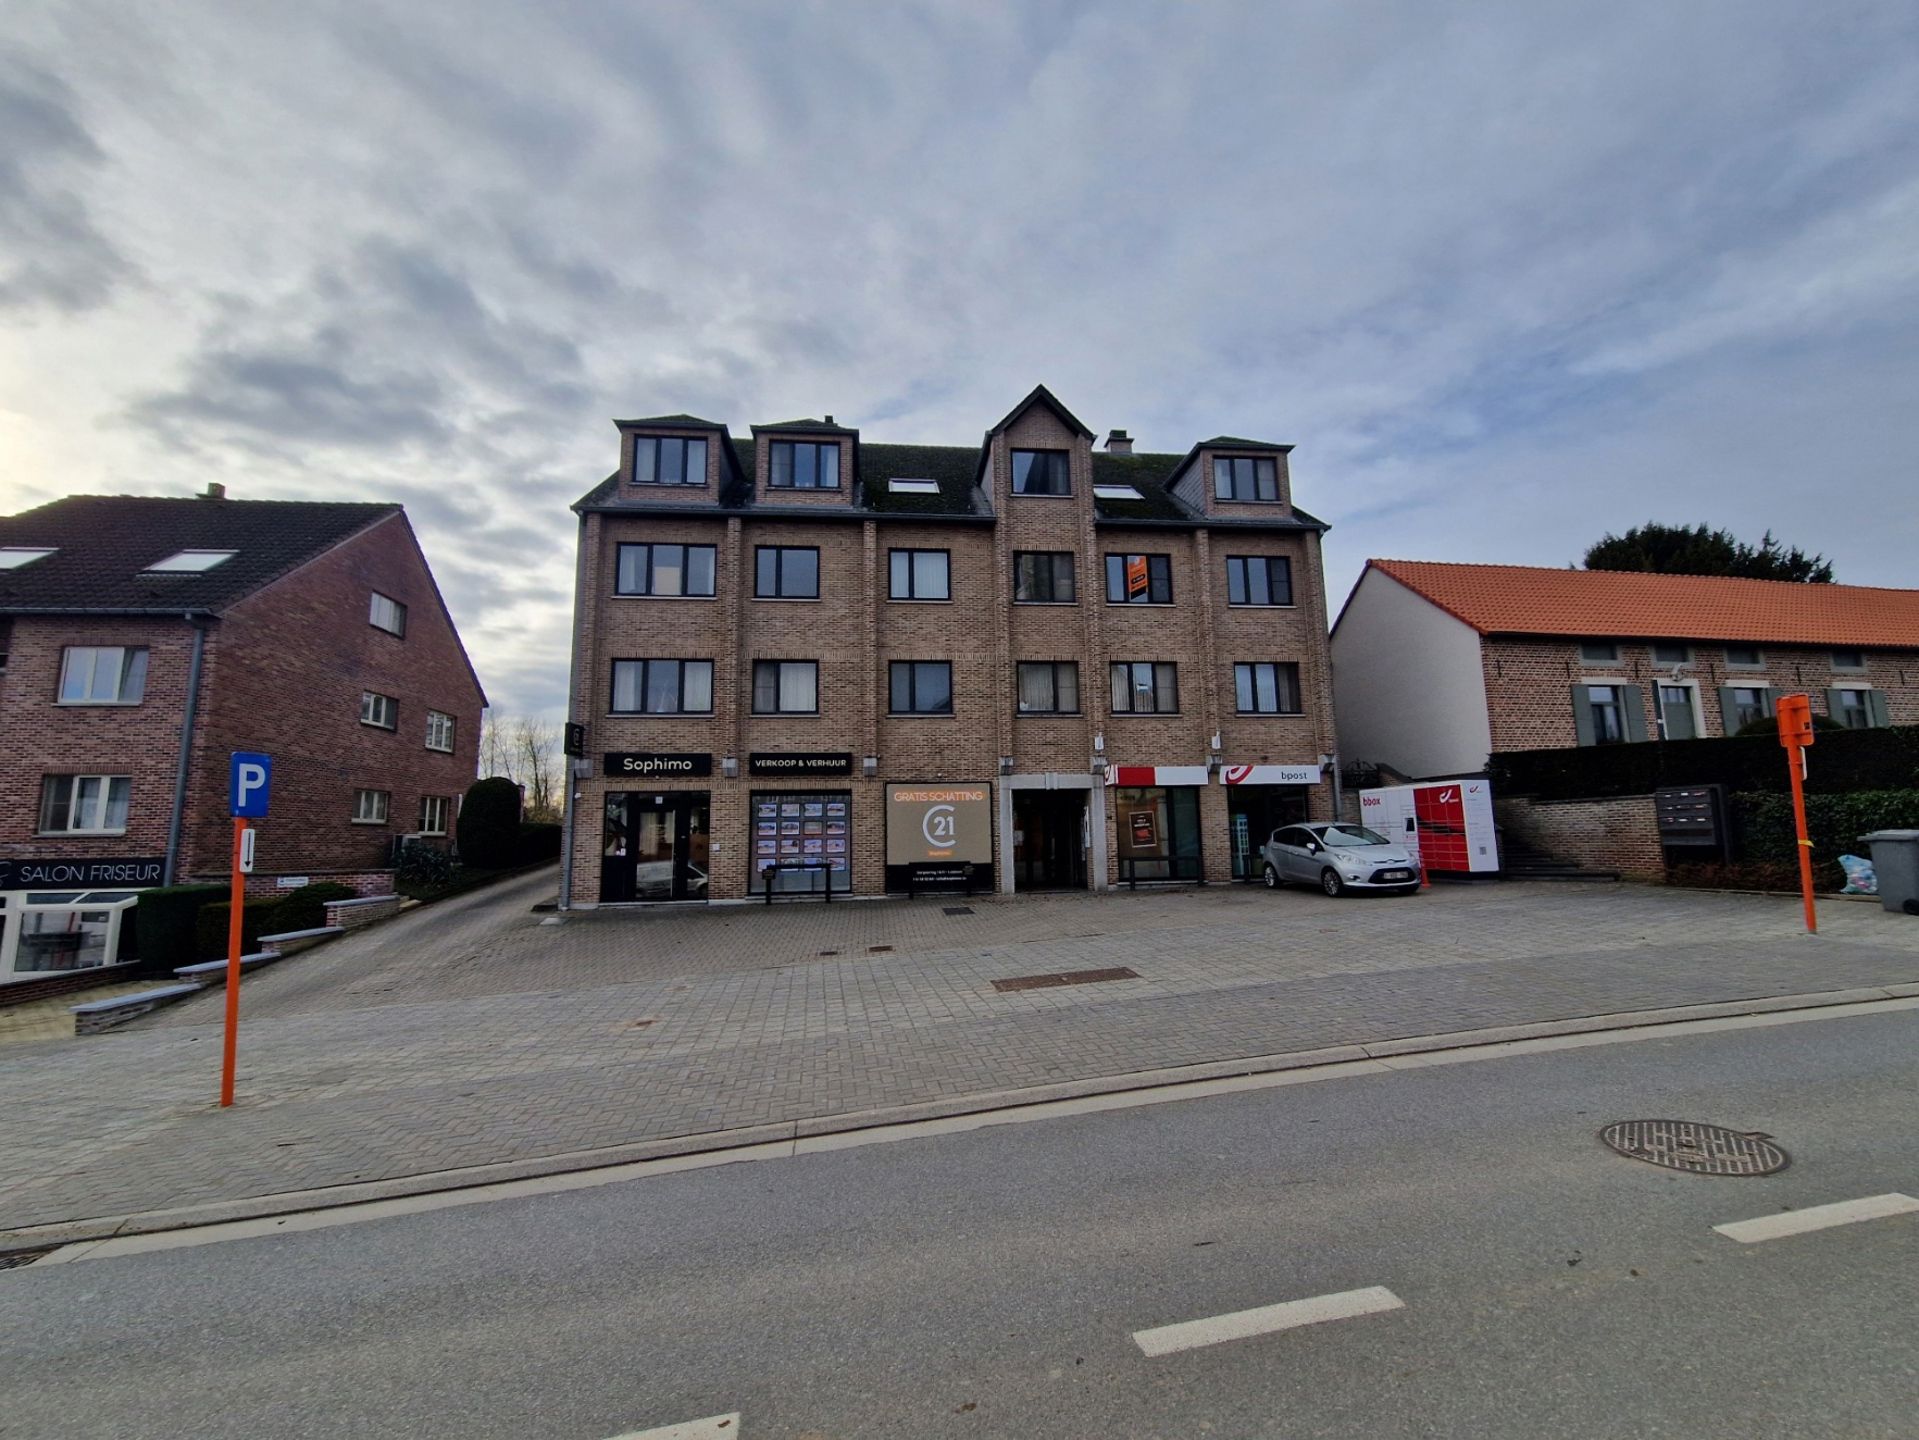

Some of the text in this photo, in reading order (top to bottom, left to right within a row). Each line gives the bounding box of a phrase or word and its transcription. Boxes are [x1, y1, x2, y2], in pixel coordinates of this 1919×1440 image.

[623, 757, 693, 774] Sophimo
[755, 759, 847, 767] VERKOOP & VERHUUR
[1281, 771, 1308, 781] bpost
[238, 763, 266, 807] P
[894, 791, 984, 802] GRATIS SCHATTING
[1363, 797, 1381, 807] bbox
[20, 864, 161, 882] SALON FRISEUR
